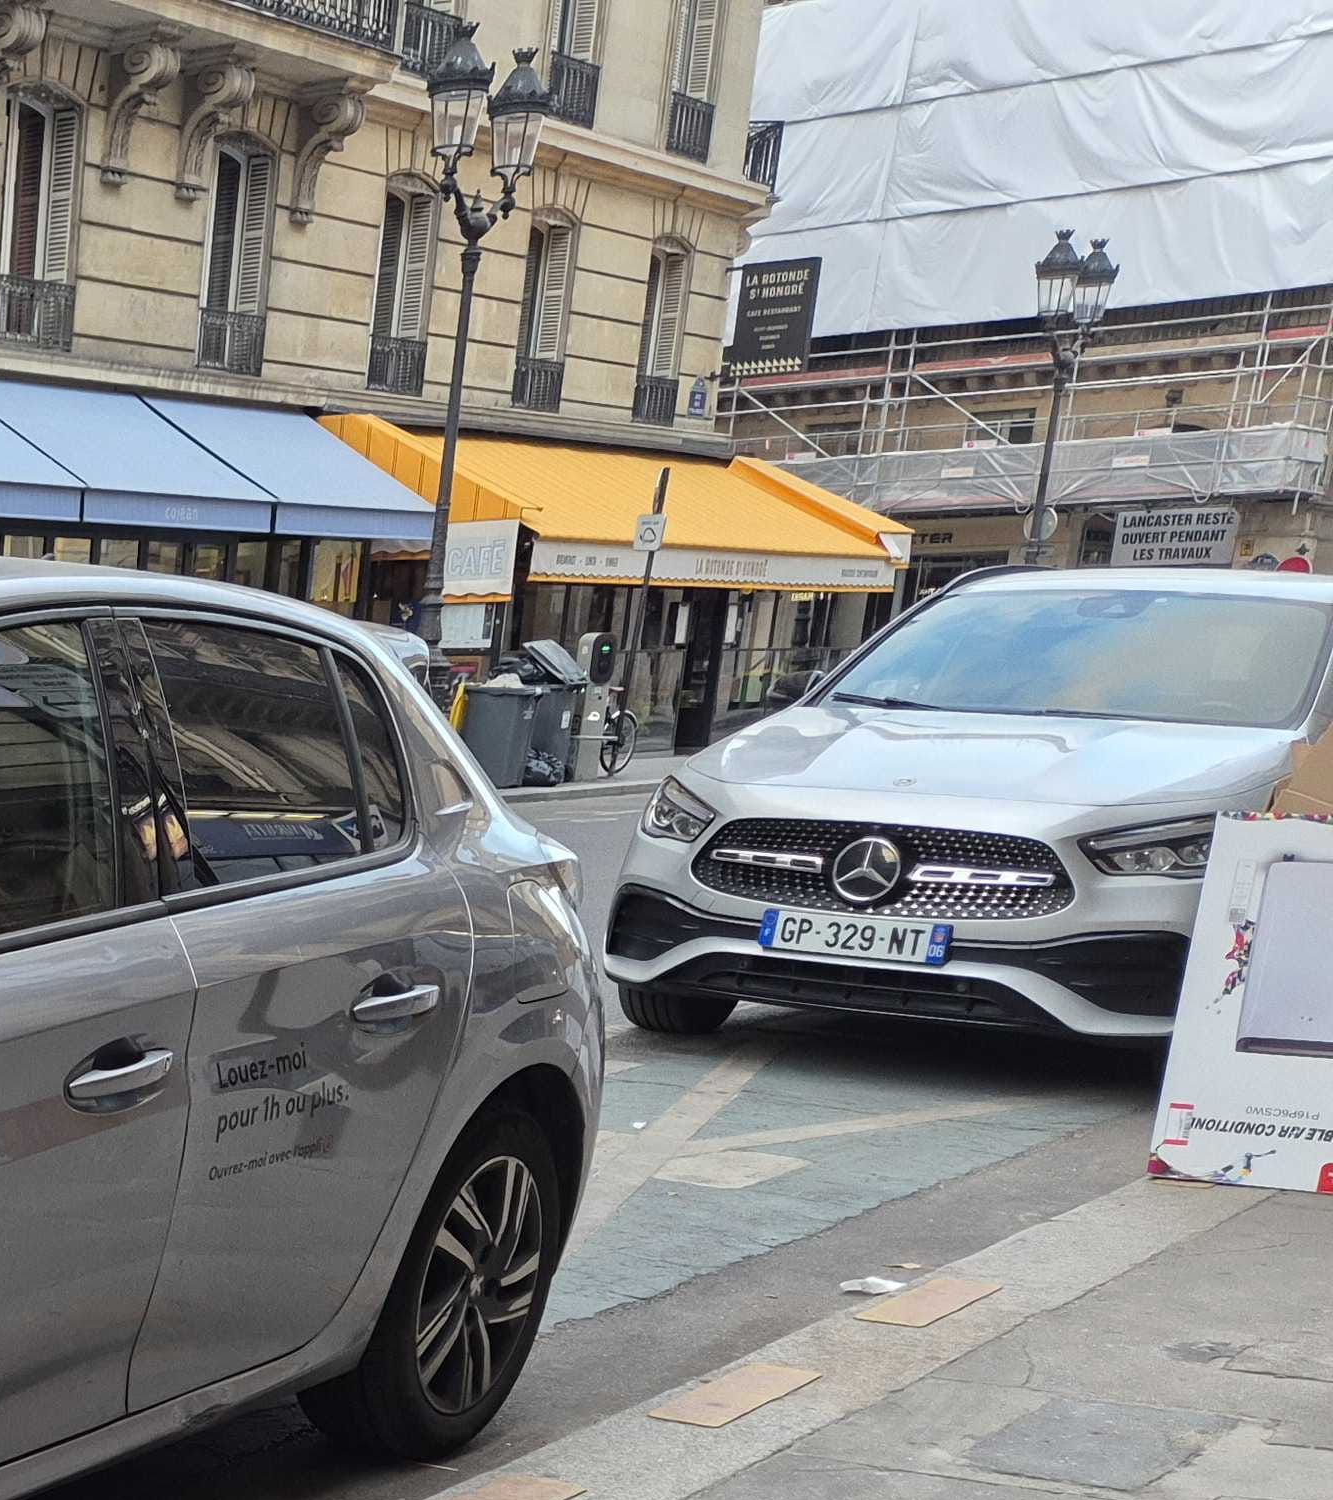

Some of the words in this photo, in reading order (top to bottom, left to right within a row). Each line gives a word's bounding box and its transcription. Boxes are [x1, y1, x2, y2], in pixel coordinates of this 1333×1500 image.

[762, 268, 811, 285] ROTONDE
[1123, 513, 1191, 528] LANCASTER
[1196, 511, 1234, 526] RESTE
[1121, 531, 1166, 545] OUVERT
[1169, 529, 1227, 543] PENDANT
[447, 538, 507, 577] CAFÉ
[1133, 549, 1153, 561] LES
[1157, 547, 1213, 560] TRAVAUX
[928, 944, 943, 958] 06
[217, 1041, 308, 1088] Louez-moi
[216, 1104, 259, 1143] pour
[263, 1094, 281, 1122] 1h
[285, 1096, 306, 1116] ou
[310, 1081, 349, 1118] plus.
